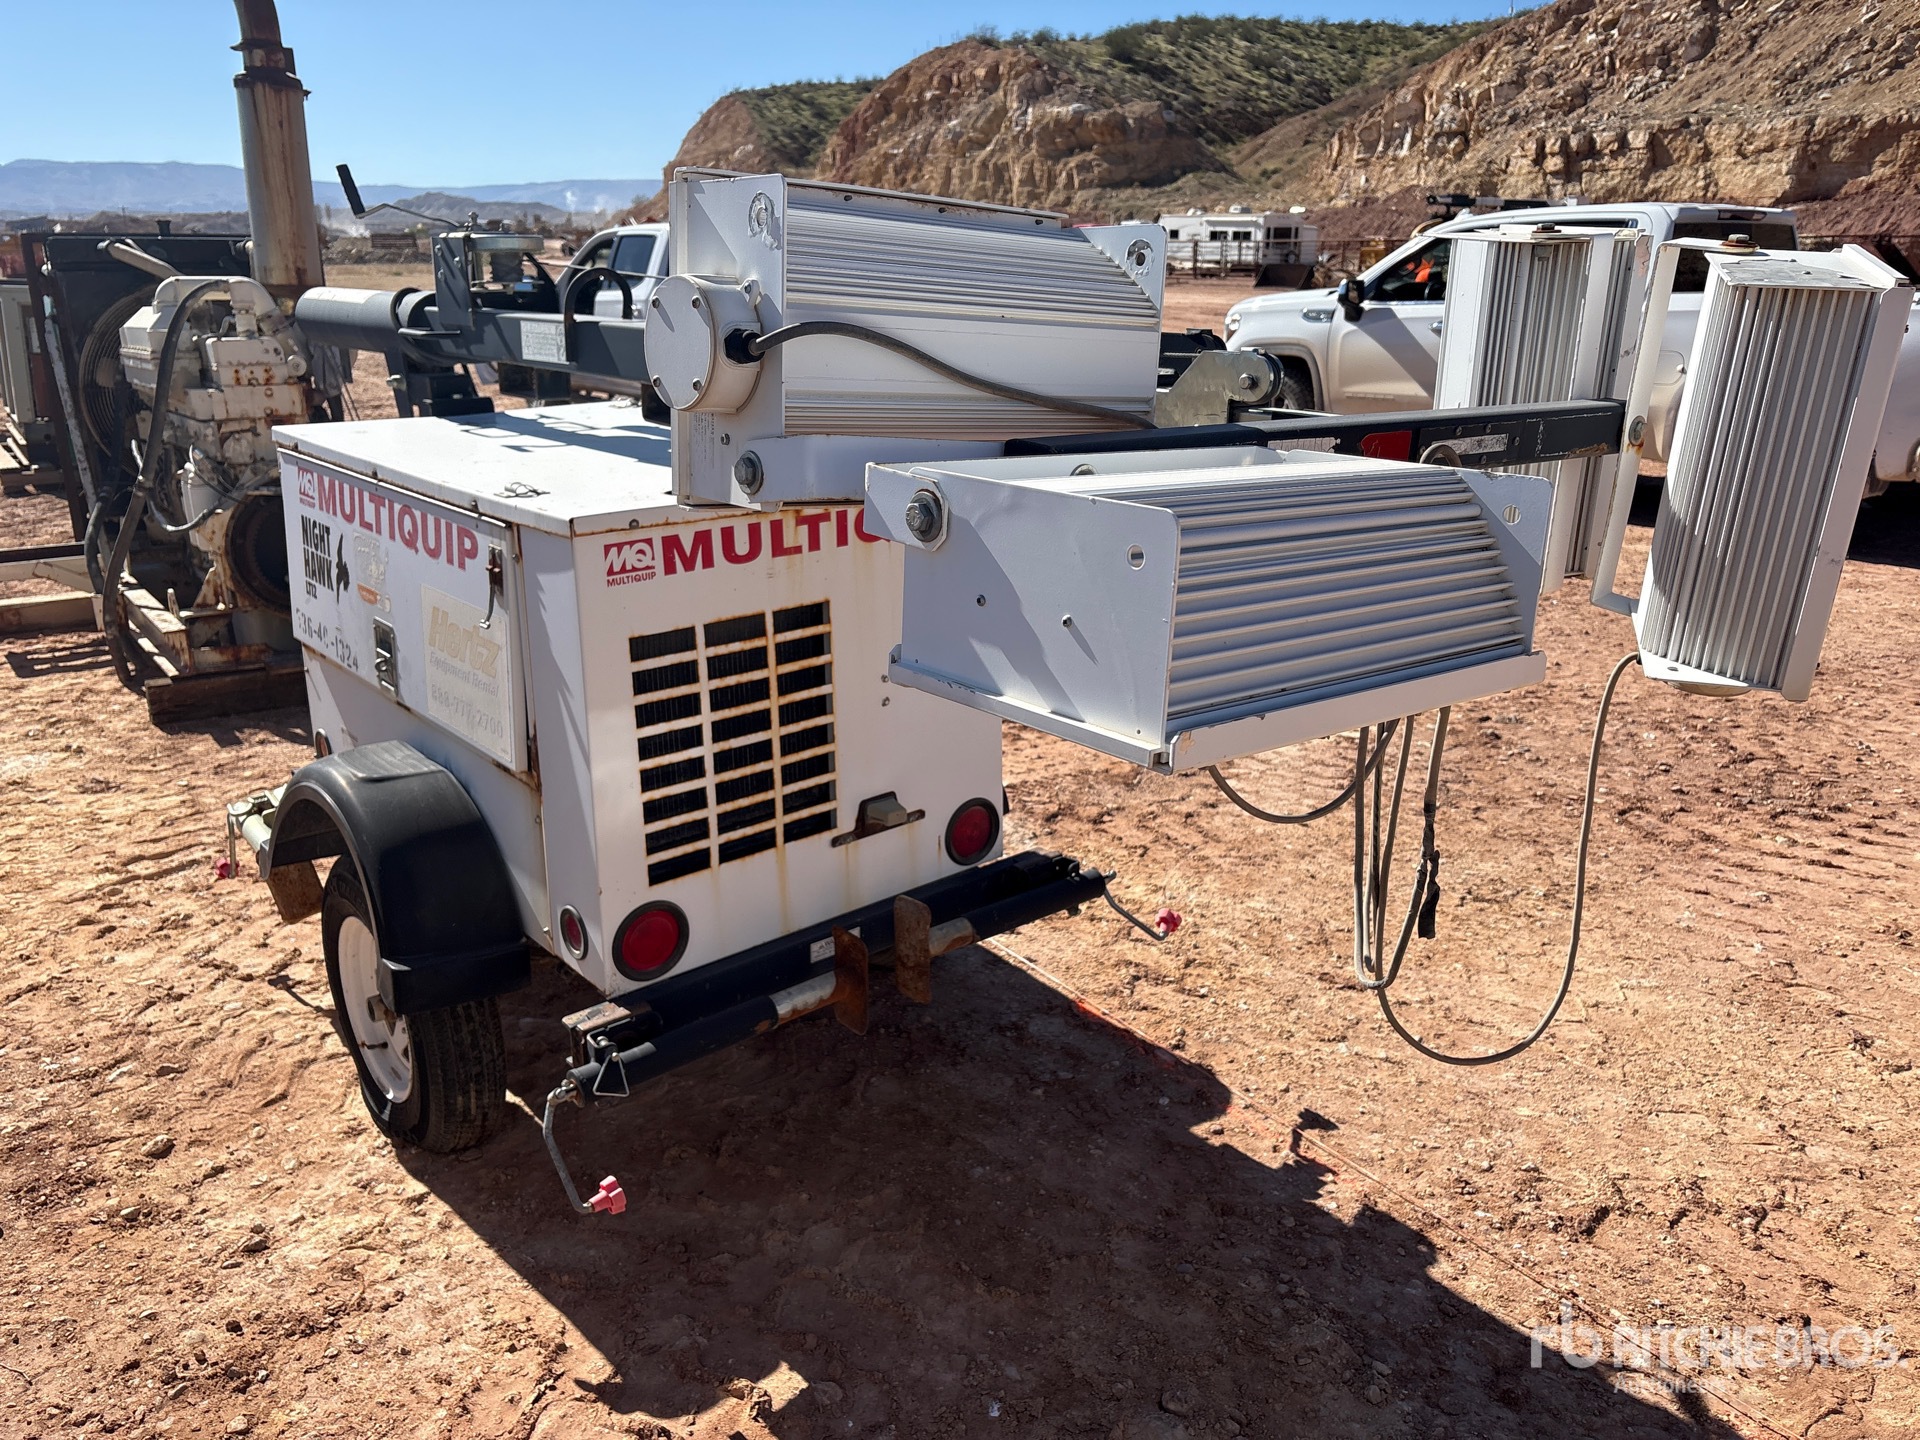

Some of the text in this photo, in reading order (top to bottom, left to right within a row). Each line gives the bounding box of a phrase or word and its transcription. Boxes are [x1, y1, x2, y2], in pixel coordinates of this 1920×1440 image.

[301, 514, 331, 558] NIGHT
[317, 474, 479, 571] MULTIQUIP
[303, 546, 334, 592] HAWK
[604, 538, 656, 577] MQ
[606, 571, 657, 588] MULTIQUIP
[428, 606, 501, 679] Hertz
[429, 651, 470, 684] Equipment
